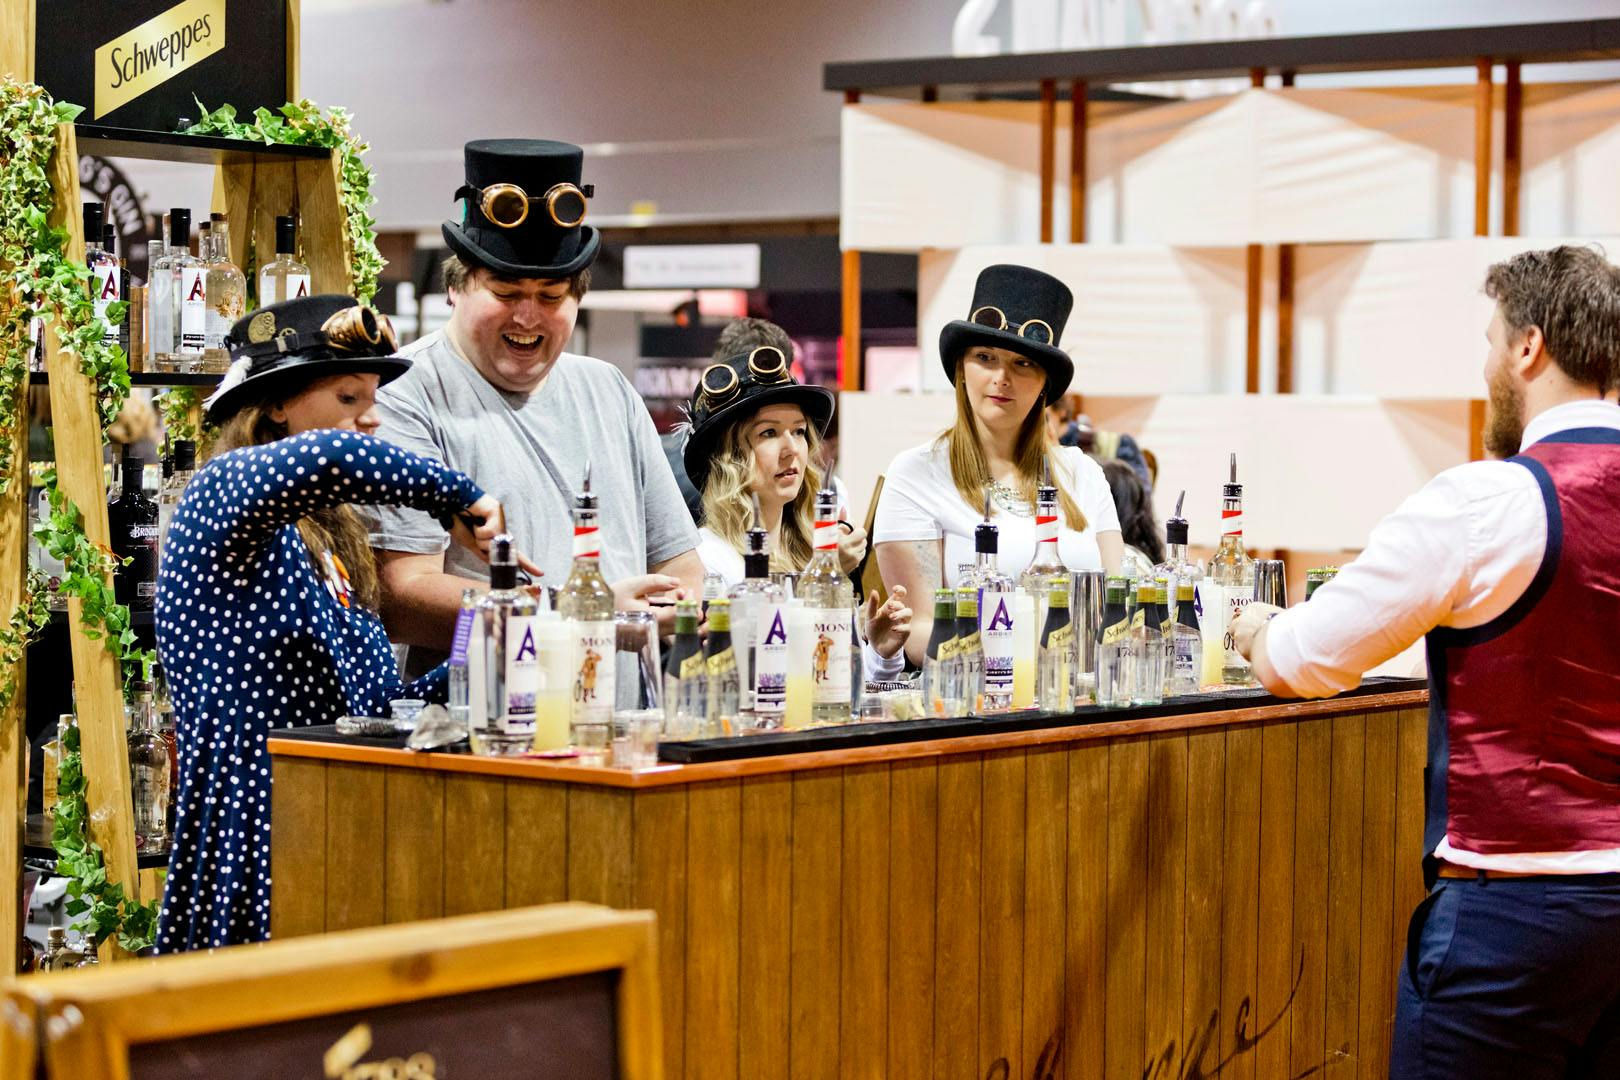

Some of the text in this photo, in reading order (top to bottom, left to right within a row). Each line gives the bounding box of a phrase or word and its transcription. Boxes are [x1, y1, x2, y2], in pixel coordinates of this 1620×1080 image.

[111, 13, 211, 89] Schweppes
[186, 271, 205, 301] A
[762, 608, 787, 645] A
[986, 596, 1013, 631] A
[515, 623, 536, 661] A
